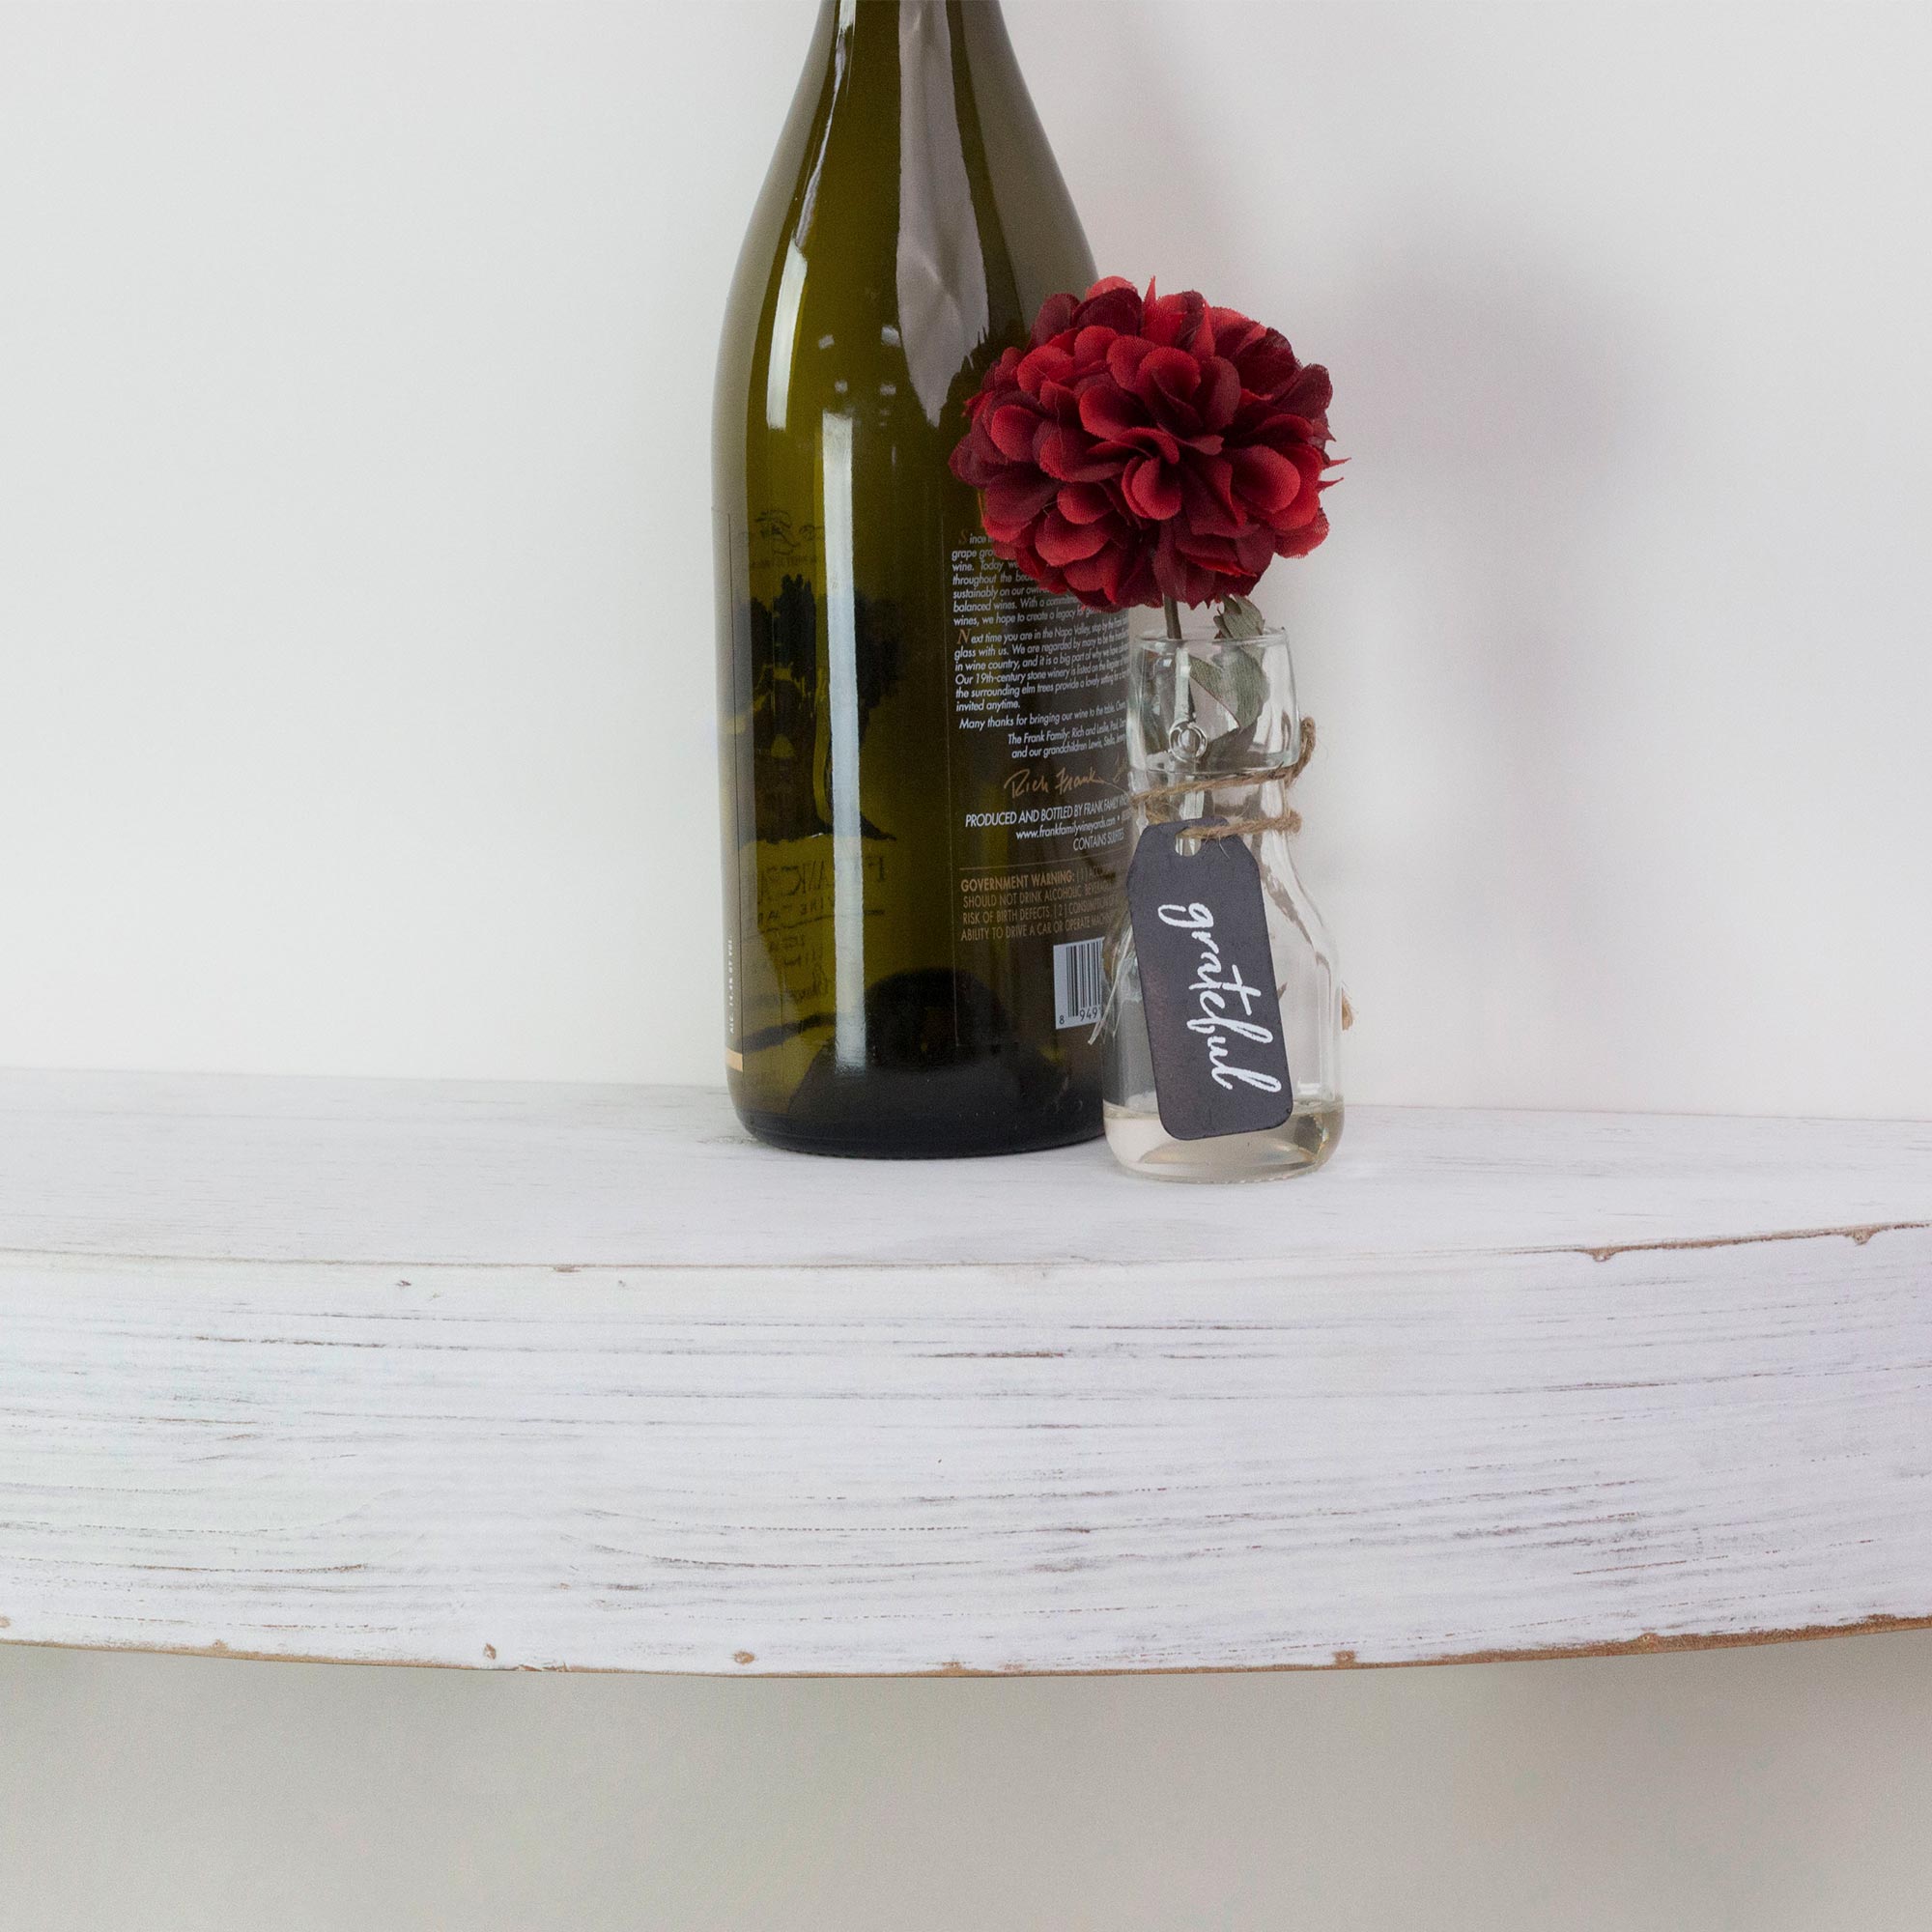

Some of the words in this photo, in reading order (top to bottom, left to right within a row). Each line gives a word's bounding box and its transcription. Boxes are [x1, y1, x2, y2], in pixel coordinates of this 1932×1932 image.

[952, 550, 977, 561] grape
[952, 560, 974, 572] wine.
[980, 557, 1004, 572] Today
[952, 572, 996, 586] throughout
[1000, 571, 1012, 582] the
[952, 584, 998, 600] sustainably
[1011, 587, 1025, 596] our
[953, 599, 991, 612] balanced
[994, 600, 1017, 610] wines.
[1020, 596, 1037, 608] With
[953, 614, 980, 627] wines,
[981, 616, 994, 625] we
[996, 611, 1015, 627] hope
[1017, 613, 1025, 622] to
[1026, 611, 1048, 621] create
[1056, 607, 1076, 621] legacy
[985, 632, 1002, 642] time
[1004, 634, 1018, 645] you
[1019, 632, 1033, 640] are
[1034, 629, 1041, 639] in
[1042, 626, 1053, 638] the
[1054, 624, 1072, 639] Napa
[954, 645, 976, 661] glass
[979, 644, 995, 657] with
[1012, 643, 1025, 655] We
[1027, 645, 1040, 654] are
[1041, 636, 1072, 655] regarded
[1073, 637, 1080, 651] by
[954, 661, 963, 671] in
[965, 660, 986, 671] wine
[988, 659, 1020, 671] country,
[1022, 654, 1038, 668] and
[1039, 655, 1044, 666] it
[1045, 655, 1052, 666] is
[1060, 651, 1070, 666] big
[1071, 653, 1084, 665] part
[954, 673, 974, 685] Our
[976, 670, 1026, 685] 19th-century
[1027, 670, 1046, 681] stone
[1047, 668, 1069, 679] winery
[955, 686, 969, 698] the
[971, 683, 1020, 697] surrounding
[1022, 682, 1036, 694] elm
[1037, 683, 1054, 693] trees
[1055, 677, 1079, 695] provide
[955, 698, 984, 712] invited
[986, 698, 1020, 713] anytime.
[959, 718, 985, 732] Many
[987, 715, 1014, 727] thanks
[1016, 713, 1028, 725] for
[1029, 712, 1060, 726] bringing
[1062, 712, 1072, 722] our
[1074, 708, 1089, 719] wine
[1008, 732, 1022, 745] The
[1023, 729, 1044, 744] Frank
[1071, 724, 1084, 738] Rich
[1085, 723, 1095, 735] and
[1011, 745, 1028, 758] and
[1029, 748, 1042, 756] our
[1043, 739, 1087, 758] grandchildren
[1003, 768, 1049, 799] Rich
[965, 811, 1017, 828] PRODUCED
[1018, 810, 1039, 824] AND
[1041, 805, 1073, 822] BOTTLED
[1073, 803, 1083, 817] BY
[1084, 799, 1103, 815] FRANK
[1073, 833, 1107, 851] CONTAINS
[960, 874, 1028, 893] GOVERNMENT
[1031, 869, 1075, 888] WARNING:
[963, 894, 997, 909] SHOULD
[999, 892, 1017, 906] NOT
[1019, 890, 1042, 904] DRINK
[1044, 884, 1082, 901] ALCOHOLIC
[962, 912, 980, 924] RISK
[982, 910, 994, 923] OF
[996, 908, 1017, 923] BIRTH
[960, 927, 990, 941] ABILITY
[992, 925, 1004, 939] TO
[1006, 924, 1027, 938] DRIVE
[1029, 923, 1035, 936] A
[1037, 921, 1052, 935] CAR
[1054, 920, 1064, 934] OR
[1157, 902, 1282, 1094] grateful
[1059, 1014, 1065, 1025] 8
